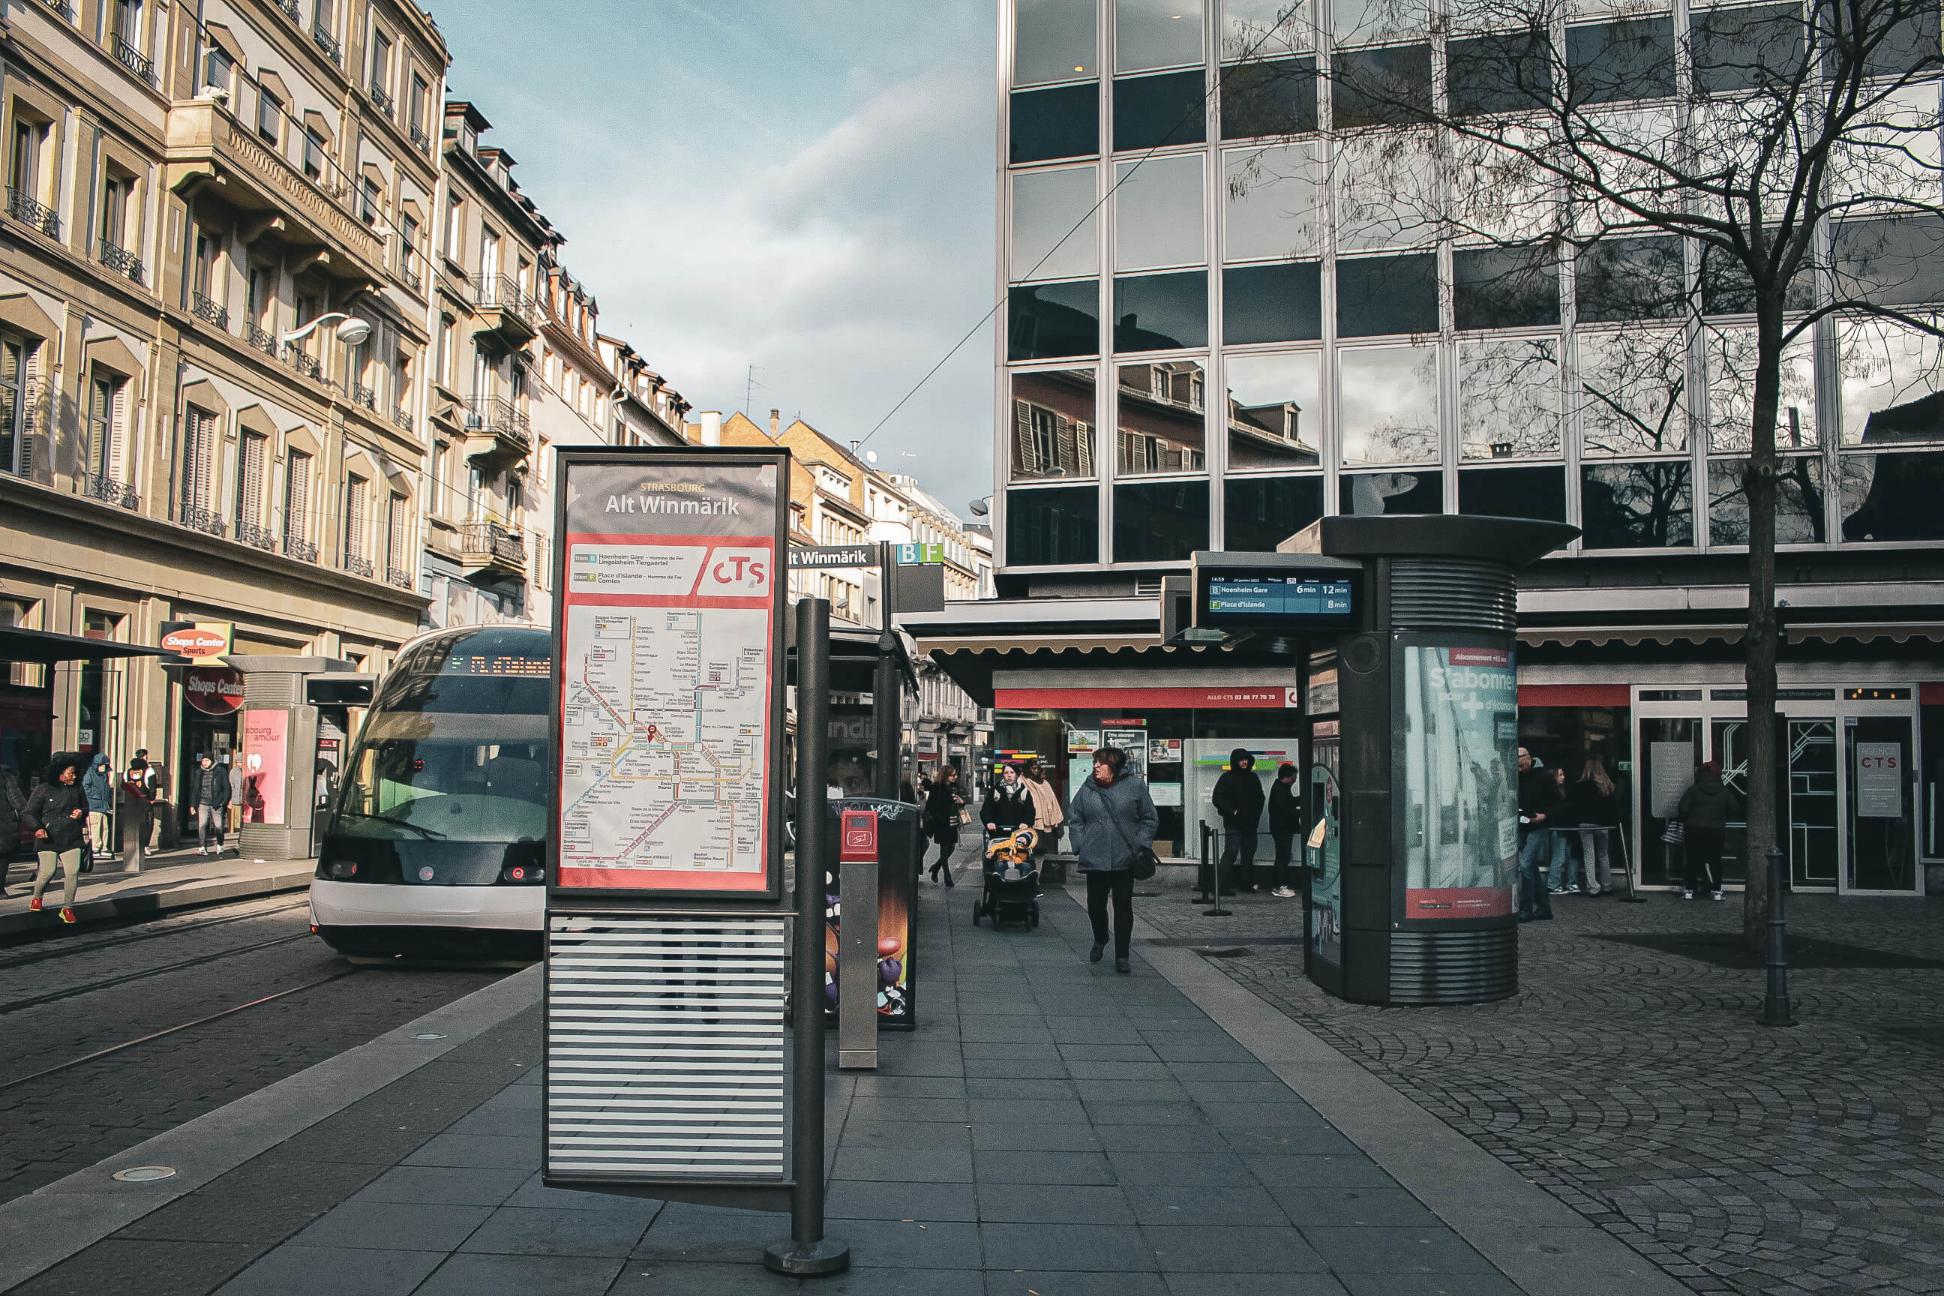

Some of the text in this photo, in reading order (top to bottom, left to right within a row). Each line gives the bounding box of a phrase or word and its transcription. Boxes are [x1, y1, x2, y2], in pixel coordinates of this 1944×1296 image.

[640, 483, 705, 493] STRASBOURG
[605, 496, 740, 516] Alt Winmärik
[788, 550, 867, 565] lt Winmärik
[902, 545, 916, 563] B
[926, 545, 938, 562] F
[713, 556, 765, 585] CTS
[166, 636, 225, 647] Shops Center
[183, 646, 206, 655] Sports
[188, 676, 216, 696] Shops
[1861, 757, 1897, 768] CTS
